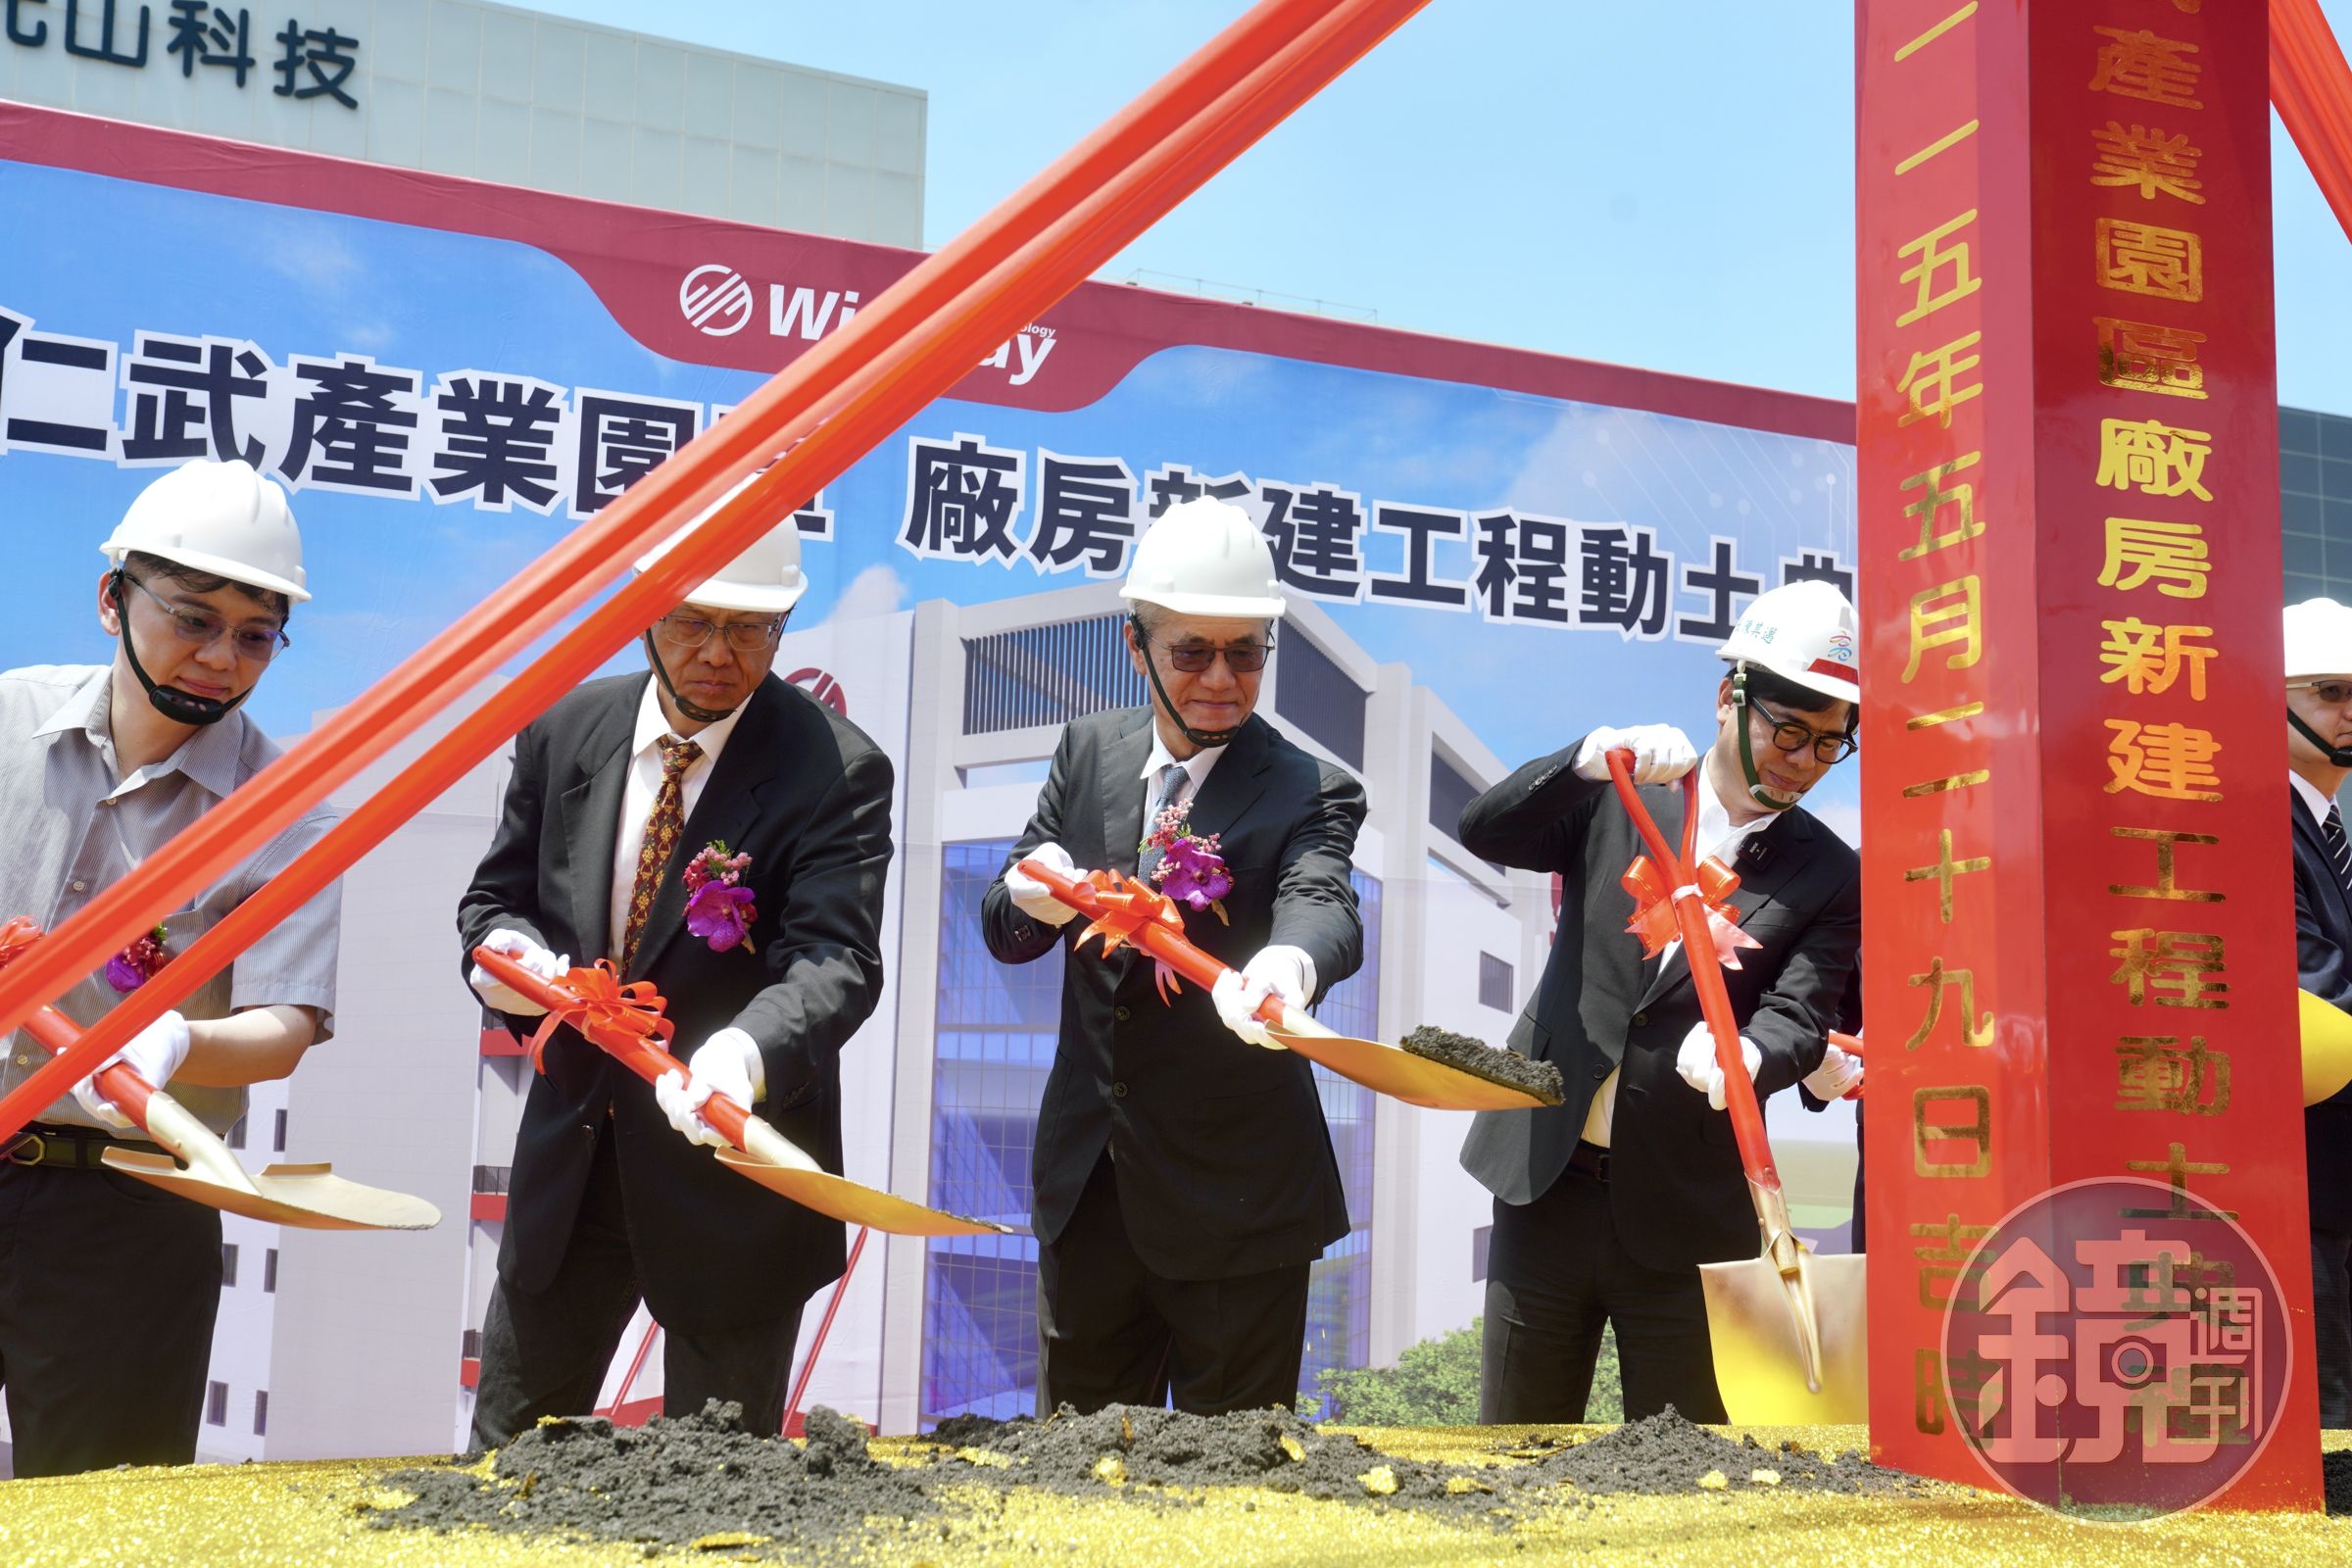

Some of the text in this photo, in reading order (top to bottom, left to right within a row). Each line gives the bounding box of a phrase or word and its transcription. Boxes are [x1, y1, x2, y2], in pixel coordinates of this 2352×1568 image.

[0, 315, 827, 534] 仁武產業園
[2087, 0, 2252, 1448] 產業園區廠房新建工程動土典禮
